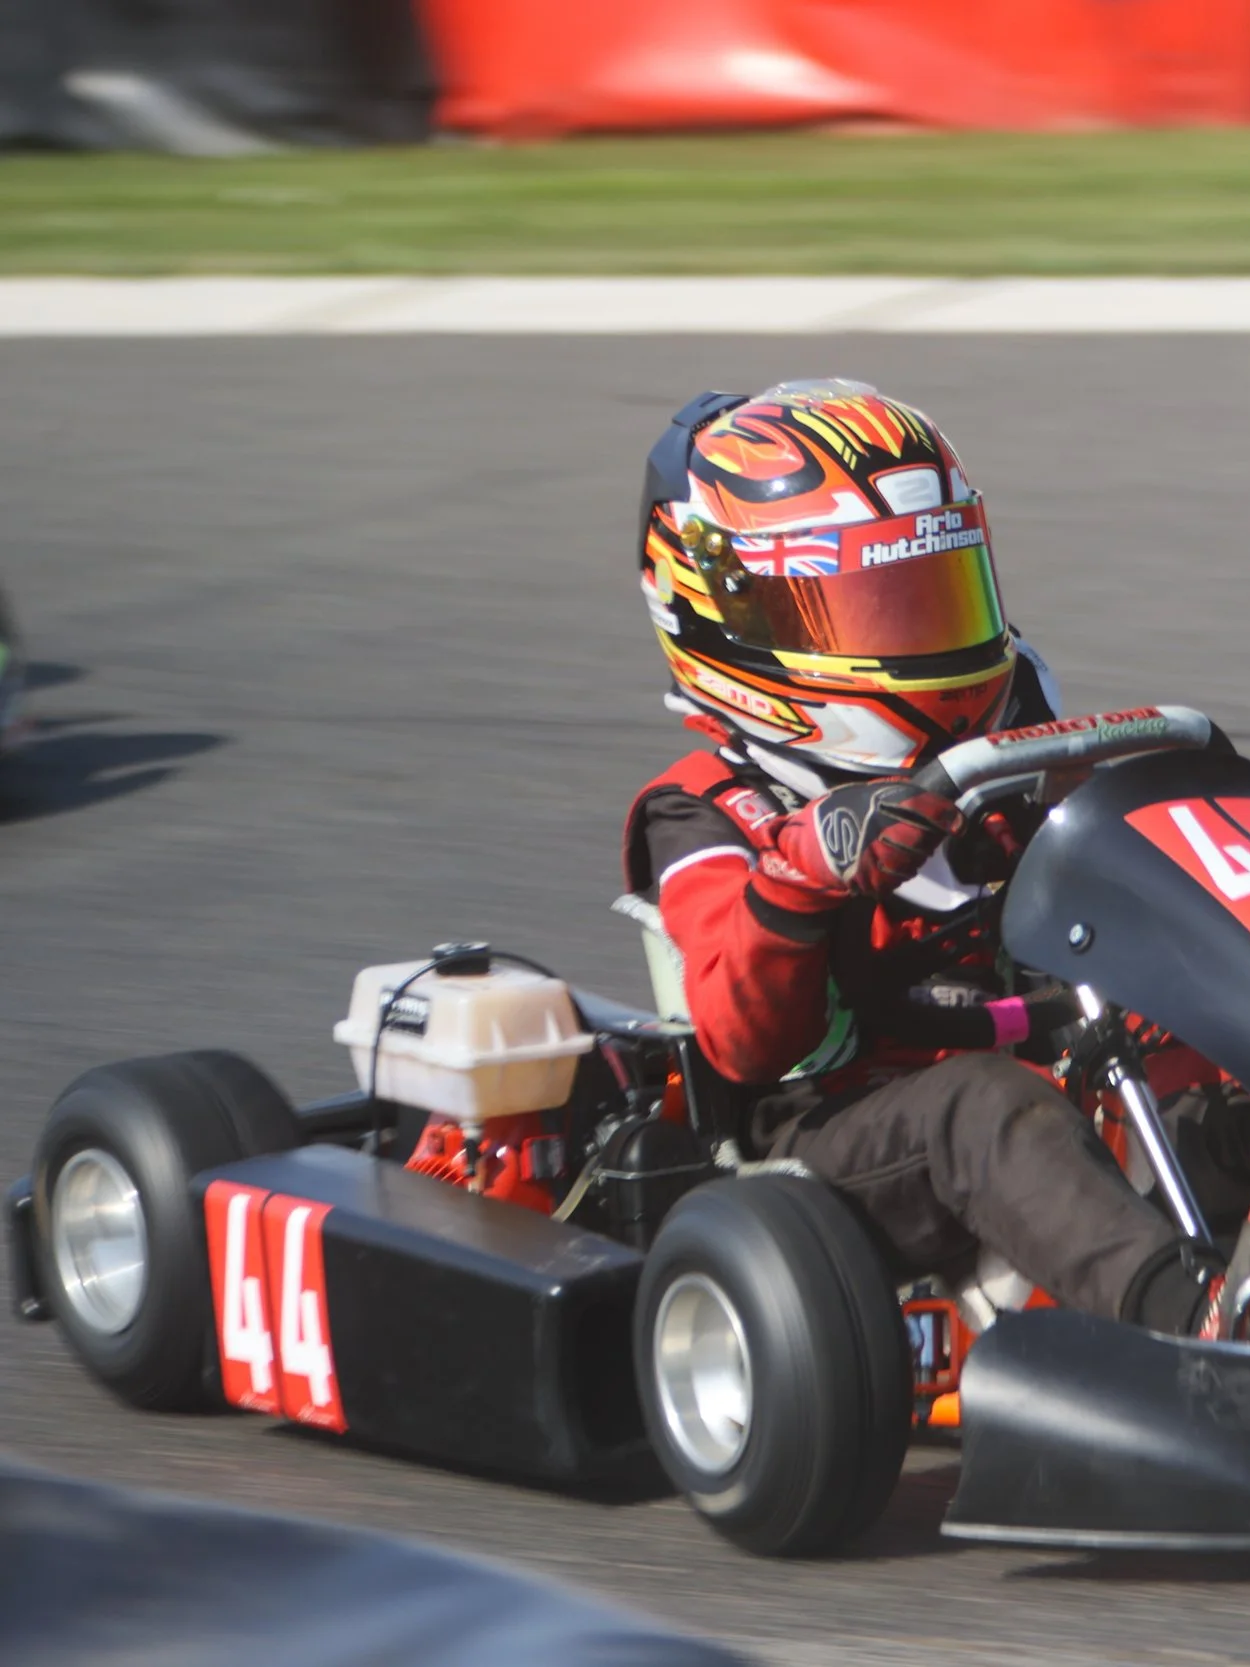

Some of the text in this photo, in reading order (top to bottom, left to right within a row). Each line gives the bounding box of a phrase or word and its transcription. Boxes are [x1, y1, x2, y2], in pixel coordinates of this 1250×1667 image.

[915, 510, 963, 537] Arlo
[861, 527, 985, 568] Hutchinson
[984, 714, 1098, 747] PROJECT
[1097, 715, 1172, 744] Racing
[222, 1192, 334, 1408] 44
